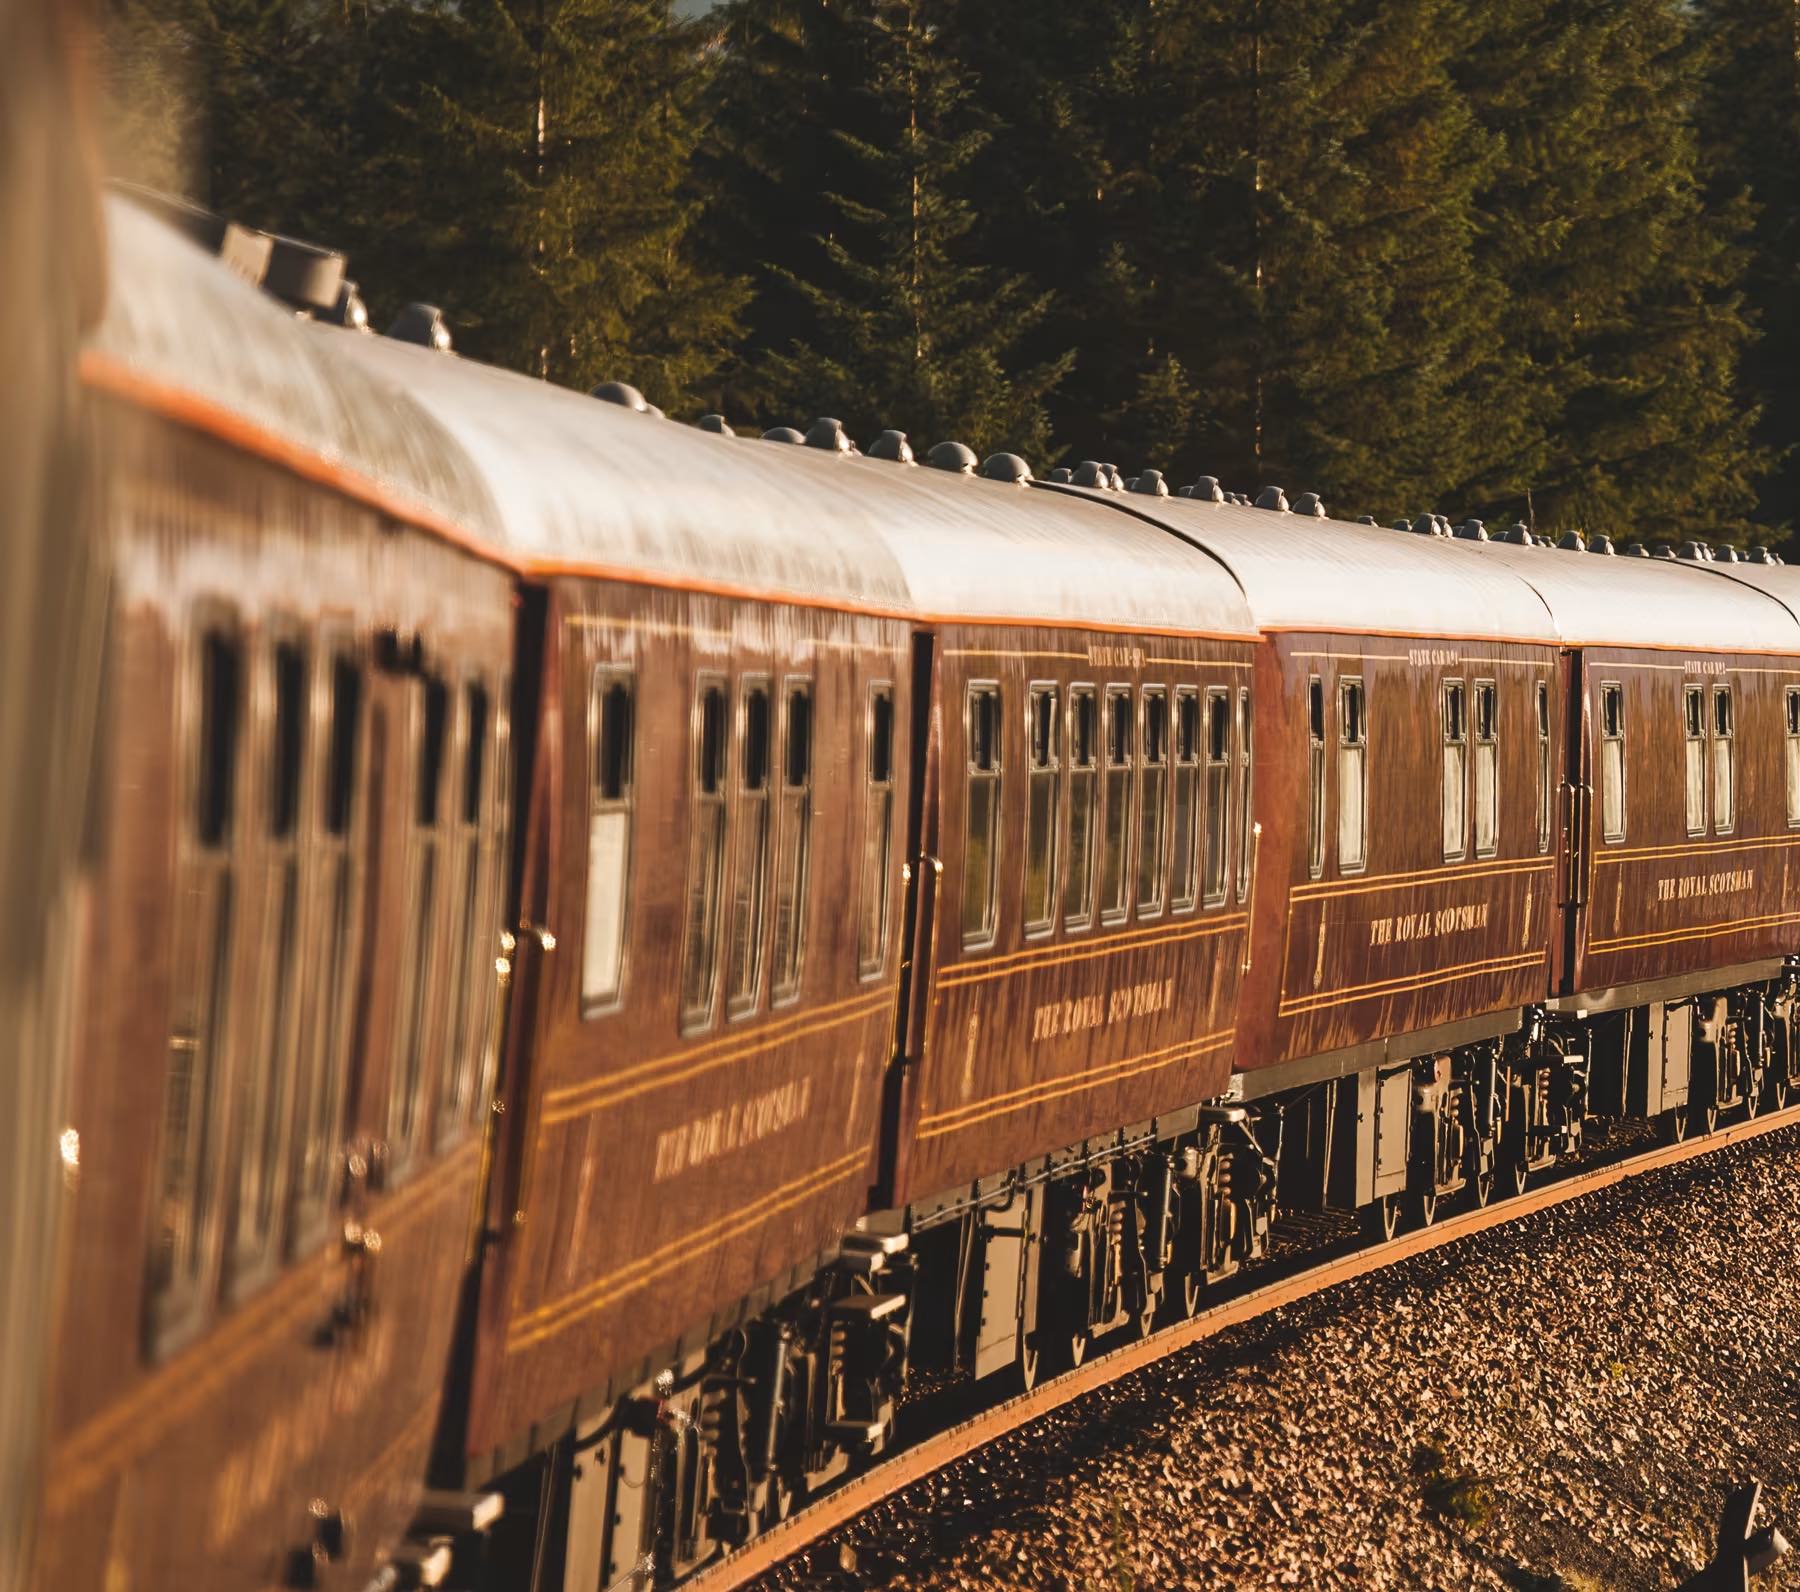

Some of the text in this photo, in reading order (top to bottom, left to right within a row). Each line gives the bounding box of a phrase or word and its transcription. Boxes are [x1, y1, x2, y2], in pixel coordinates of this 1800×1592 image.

[1658, 868, 1754, 902] THE ROYAL SCOTSMAN
[1369, 902, 1489, 947] THE ROYAL SCOTSMAN
